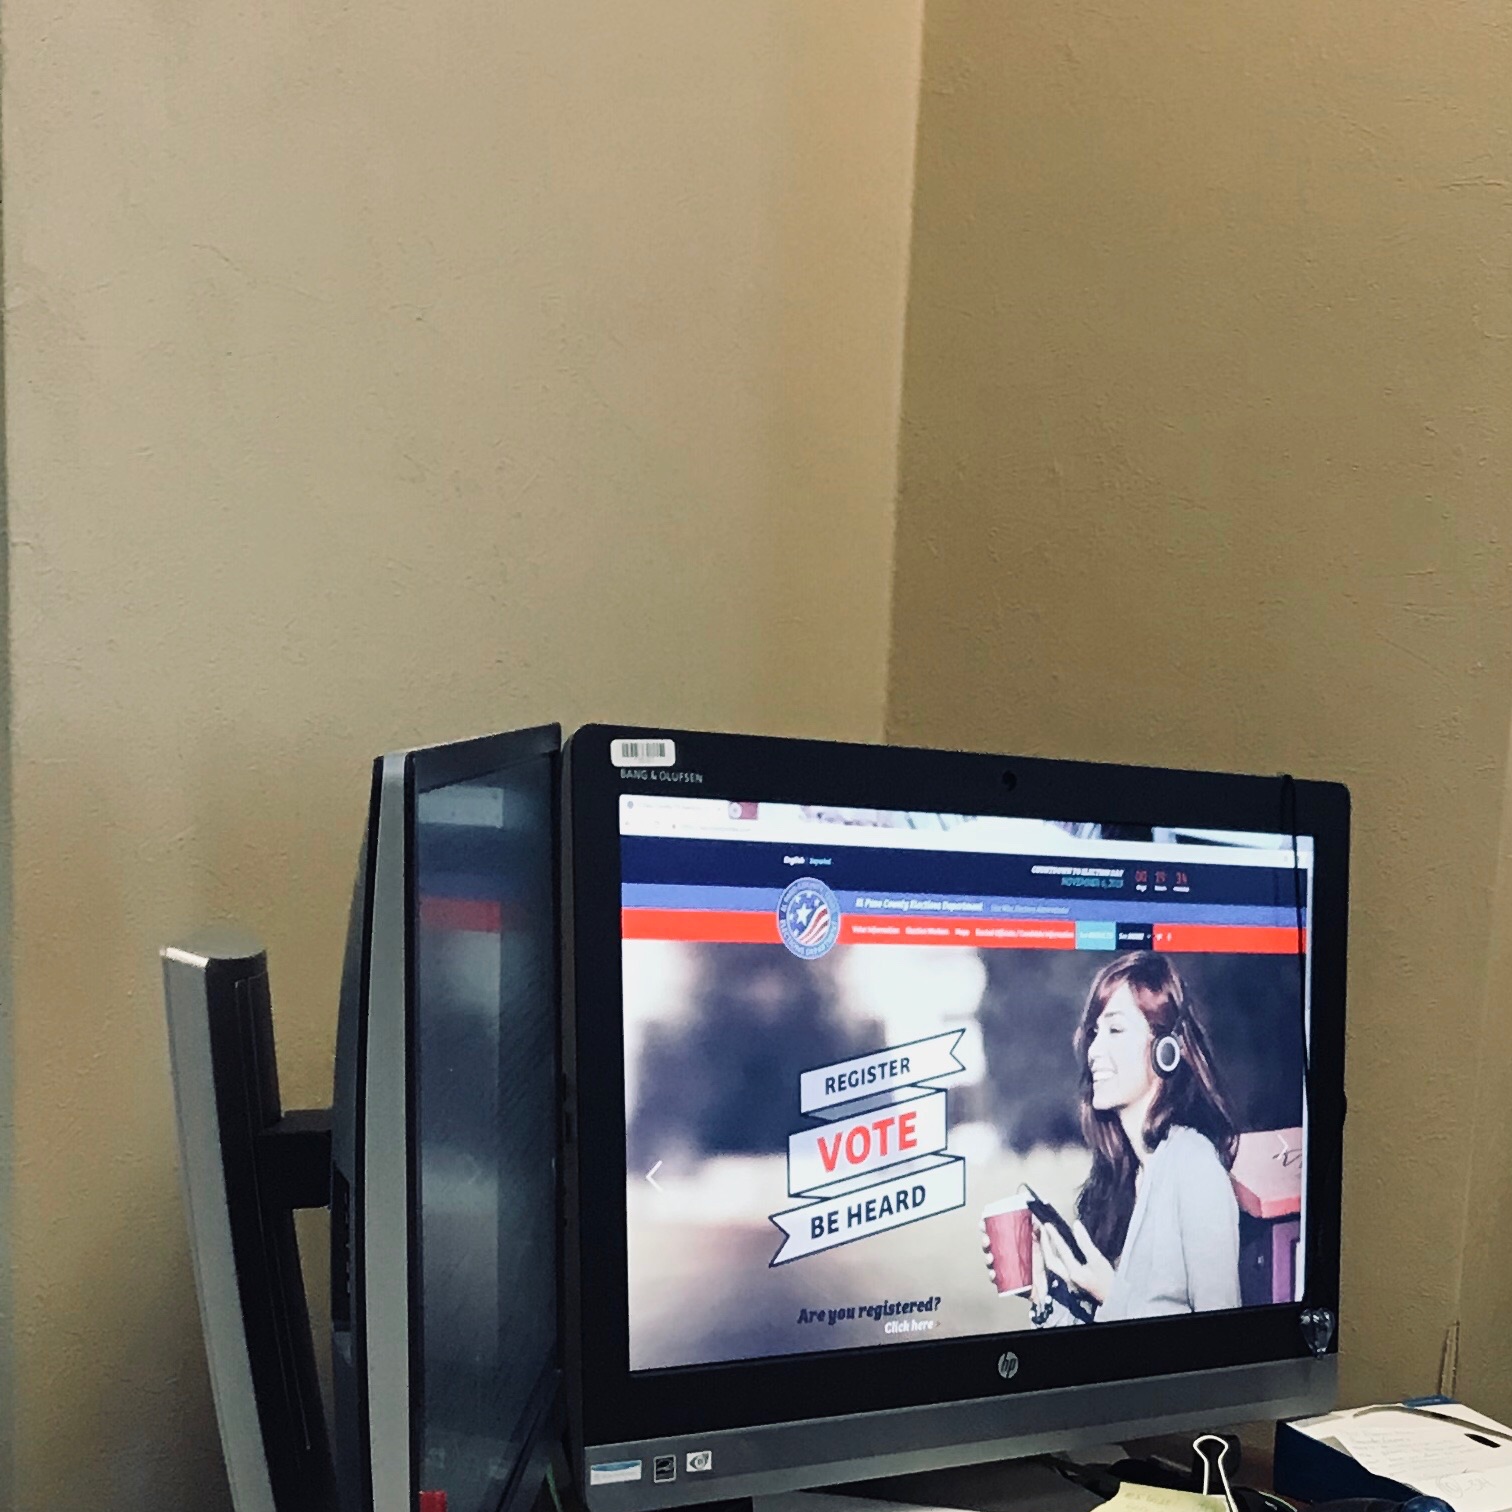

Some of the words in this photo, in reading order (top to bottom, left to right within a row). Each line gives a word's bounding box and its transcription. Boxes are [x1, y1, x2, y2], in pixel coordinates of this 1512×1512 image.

[620, 768, 647, 780] BANG
[650, 770, 657, 780] &
[659, 771, 703, 783] OLUFSEN
[824, 1058, 912, 1095] REGISTER
[816, 1111, 919, 1174] VOTE
[809, 1214, 840, 1240] BE
[845, 1184, 927, 1231] HEARD
[797, 1308, 825, 1324] Are
[827, 1306, 856, 1325] you
[858, 1296, 941, 1320] registered?
[884, 1319, 910, 1334] Click
[911, 1319, 934, 1331] here
[998, 1352, 1019, 1379] hp
